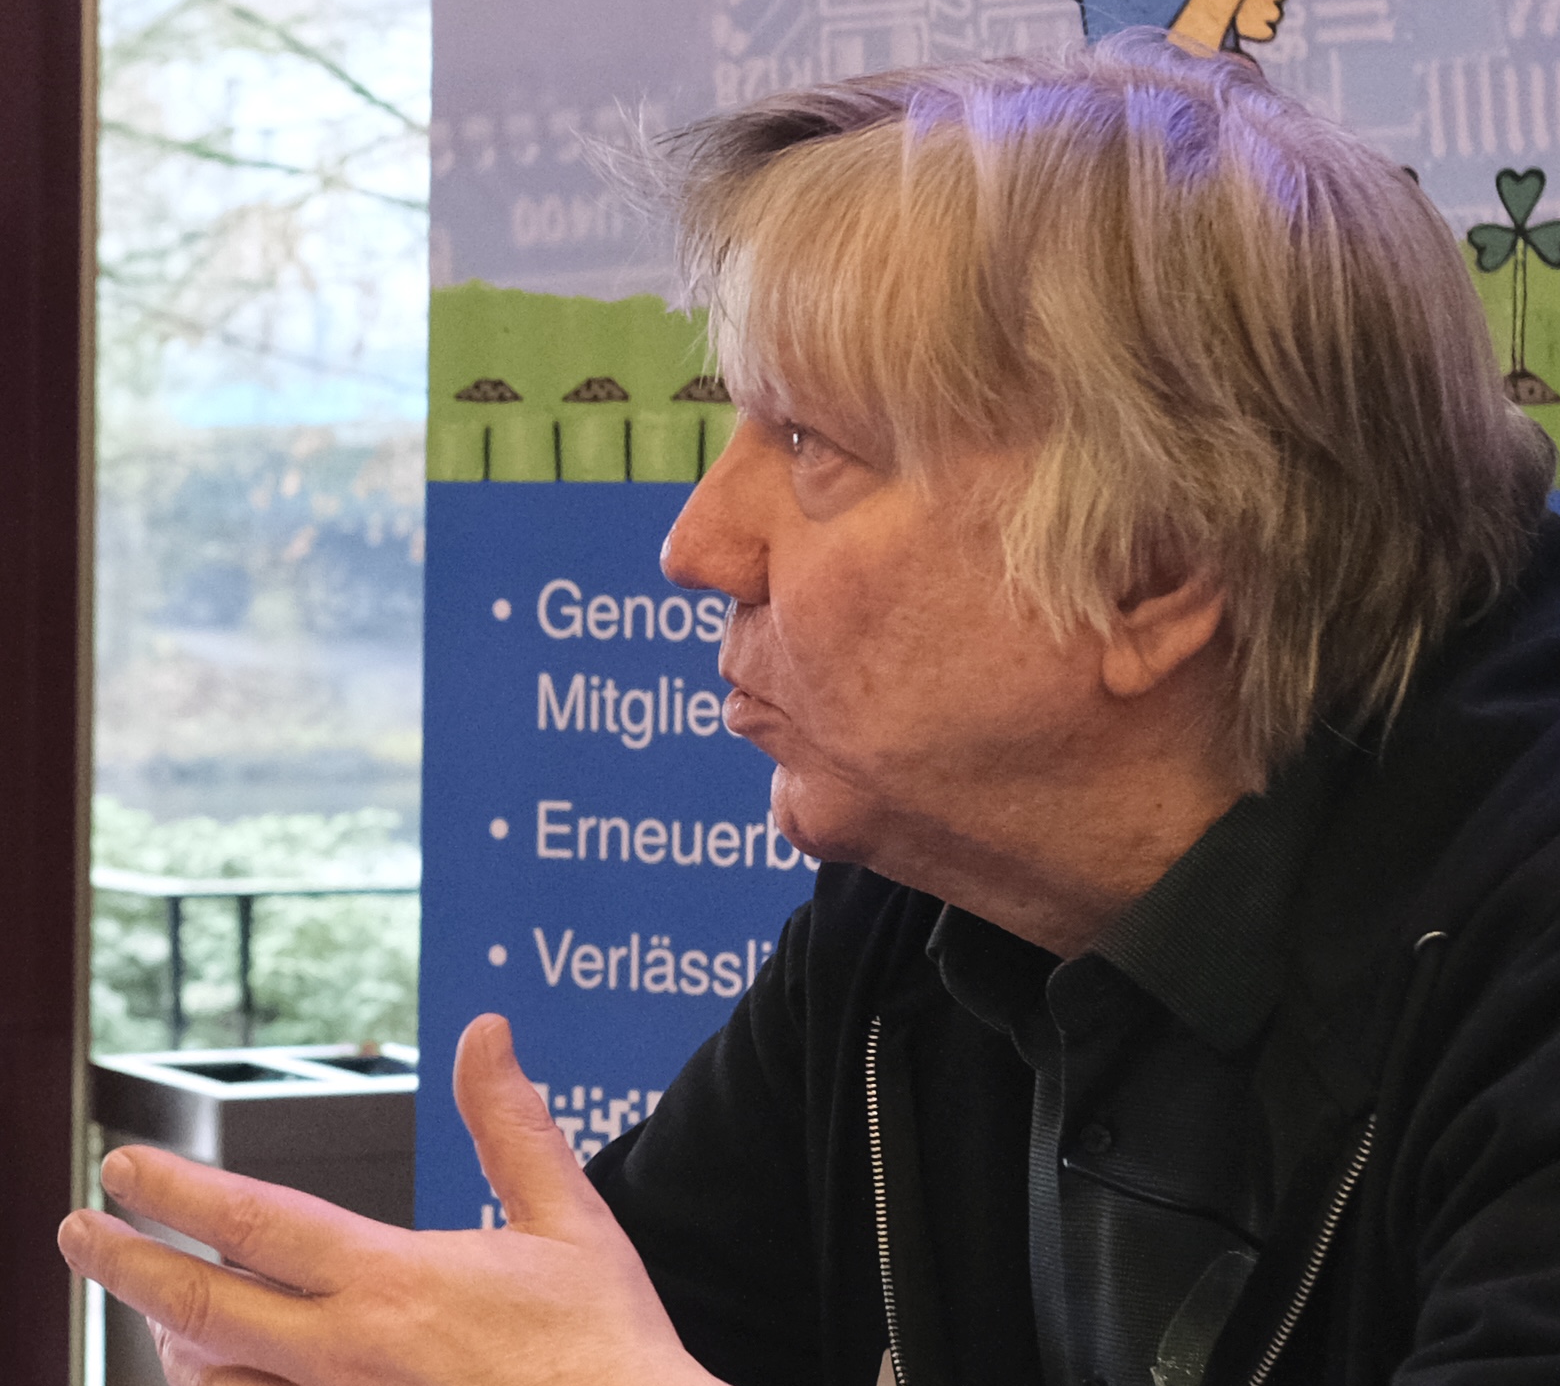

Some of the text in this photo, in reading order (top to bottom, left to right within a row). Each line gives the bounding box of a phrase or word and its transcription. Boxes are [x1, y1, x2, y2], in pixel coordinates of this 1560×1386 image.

[536, 577, 726, 645] Genos
[536, 672, 722, 750] Mitglie
[535, 800, 822, 873] Erneuerb
